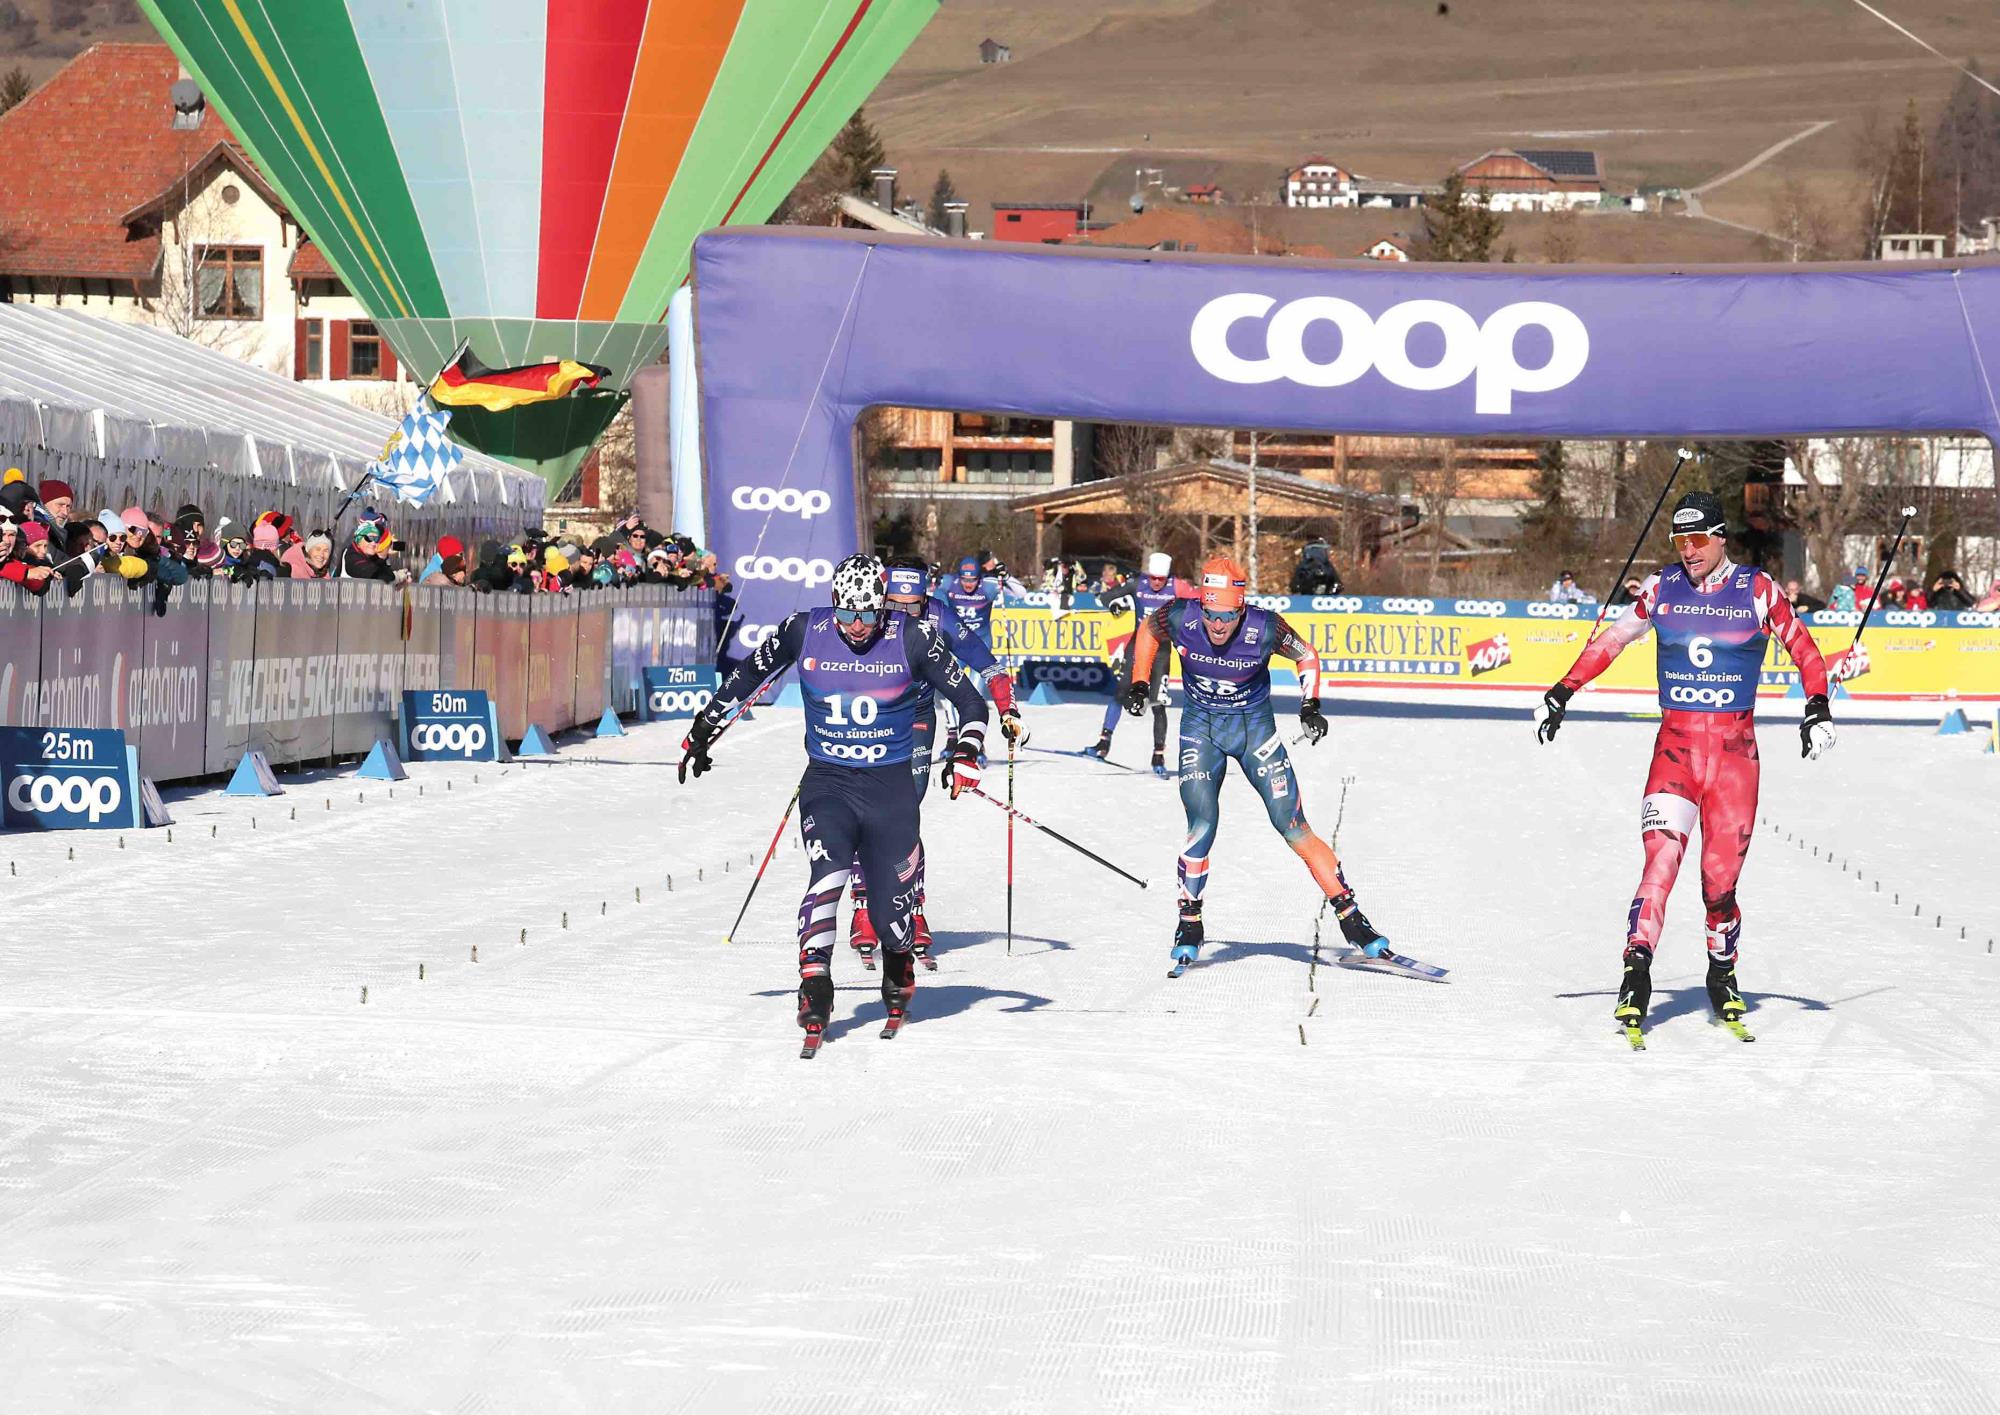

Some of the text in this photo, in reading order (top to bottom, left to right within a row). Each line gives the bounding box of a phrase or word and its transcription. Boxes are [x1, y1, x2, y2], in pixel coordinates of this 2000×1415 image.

[1190, 292, 1590, 415] coop
[731, 485, 831, 519] coop
[735, 555, 834, 588] coop
[955, 605, 977, 619] 34
[1312, 596, 1363, 614] coop
[1382, 598, 1434, 615] coop
[1455, 600, 1506, 617] coop
[1527, 602, 1579, 620] coop
[1672, 603, 1753, 620] azerbaijan
[1813, 610, 1863, 627] coop
[1885, 611, 1937, 628] coop
[738, 623, 779, 649] co
[1687, 636, 1714, 669] 6
[668, 667, 697, 684] 75m
[819, 658, 904, 677] azerbaijan
[1033, 666, 1103, 686] coop
[1664, 671, 1694, 681] Toblach
[129, 639, 198, 750] azerbaijan
[225, 657, 302, 727] SKECHERS
[302, 654, 378, 718] SKECHERS
[1669, 686, 1736, 708] coop
[432, 692, 467, 714] 50m
[648, 689, 713, 716] coop
[823, 694, 878, 726] 10
[41, 732, 94, 761] 25m
[411, 723, 487, 757] coop
[820, 741, 888, 763] coop
[8, 776, 122, 823] coop
